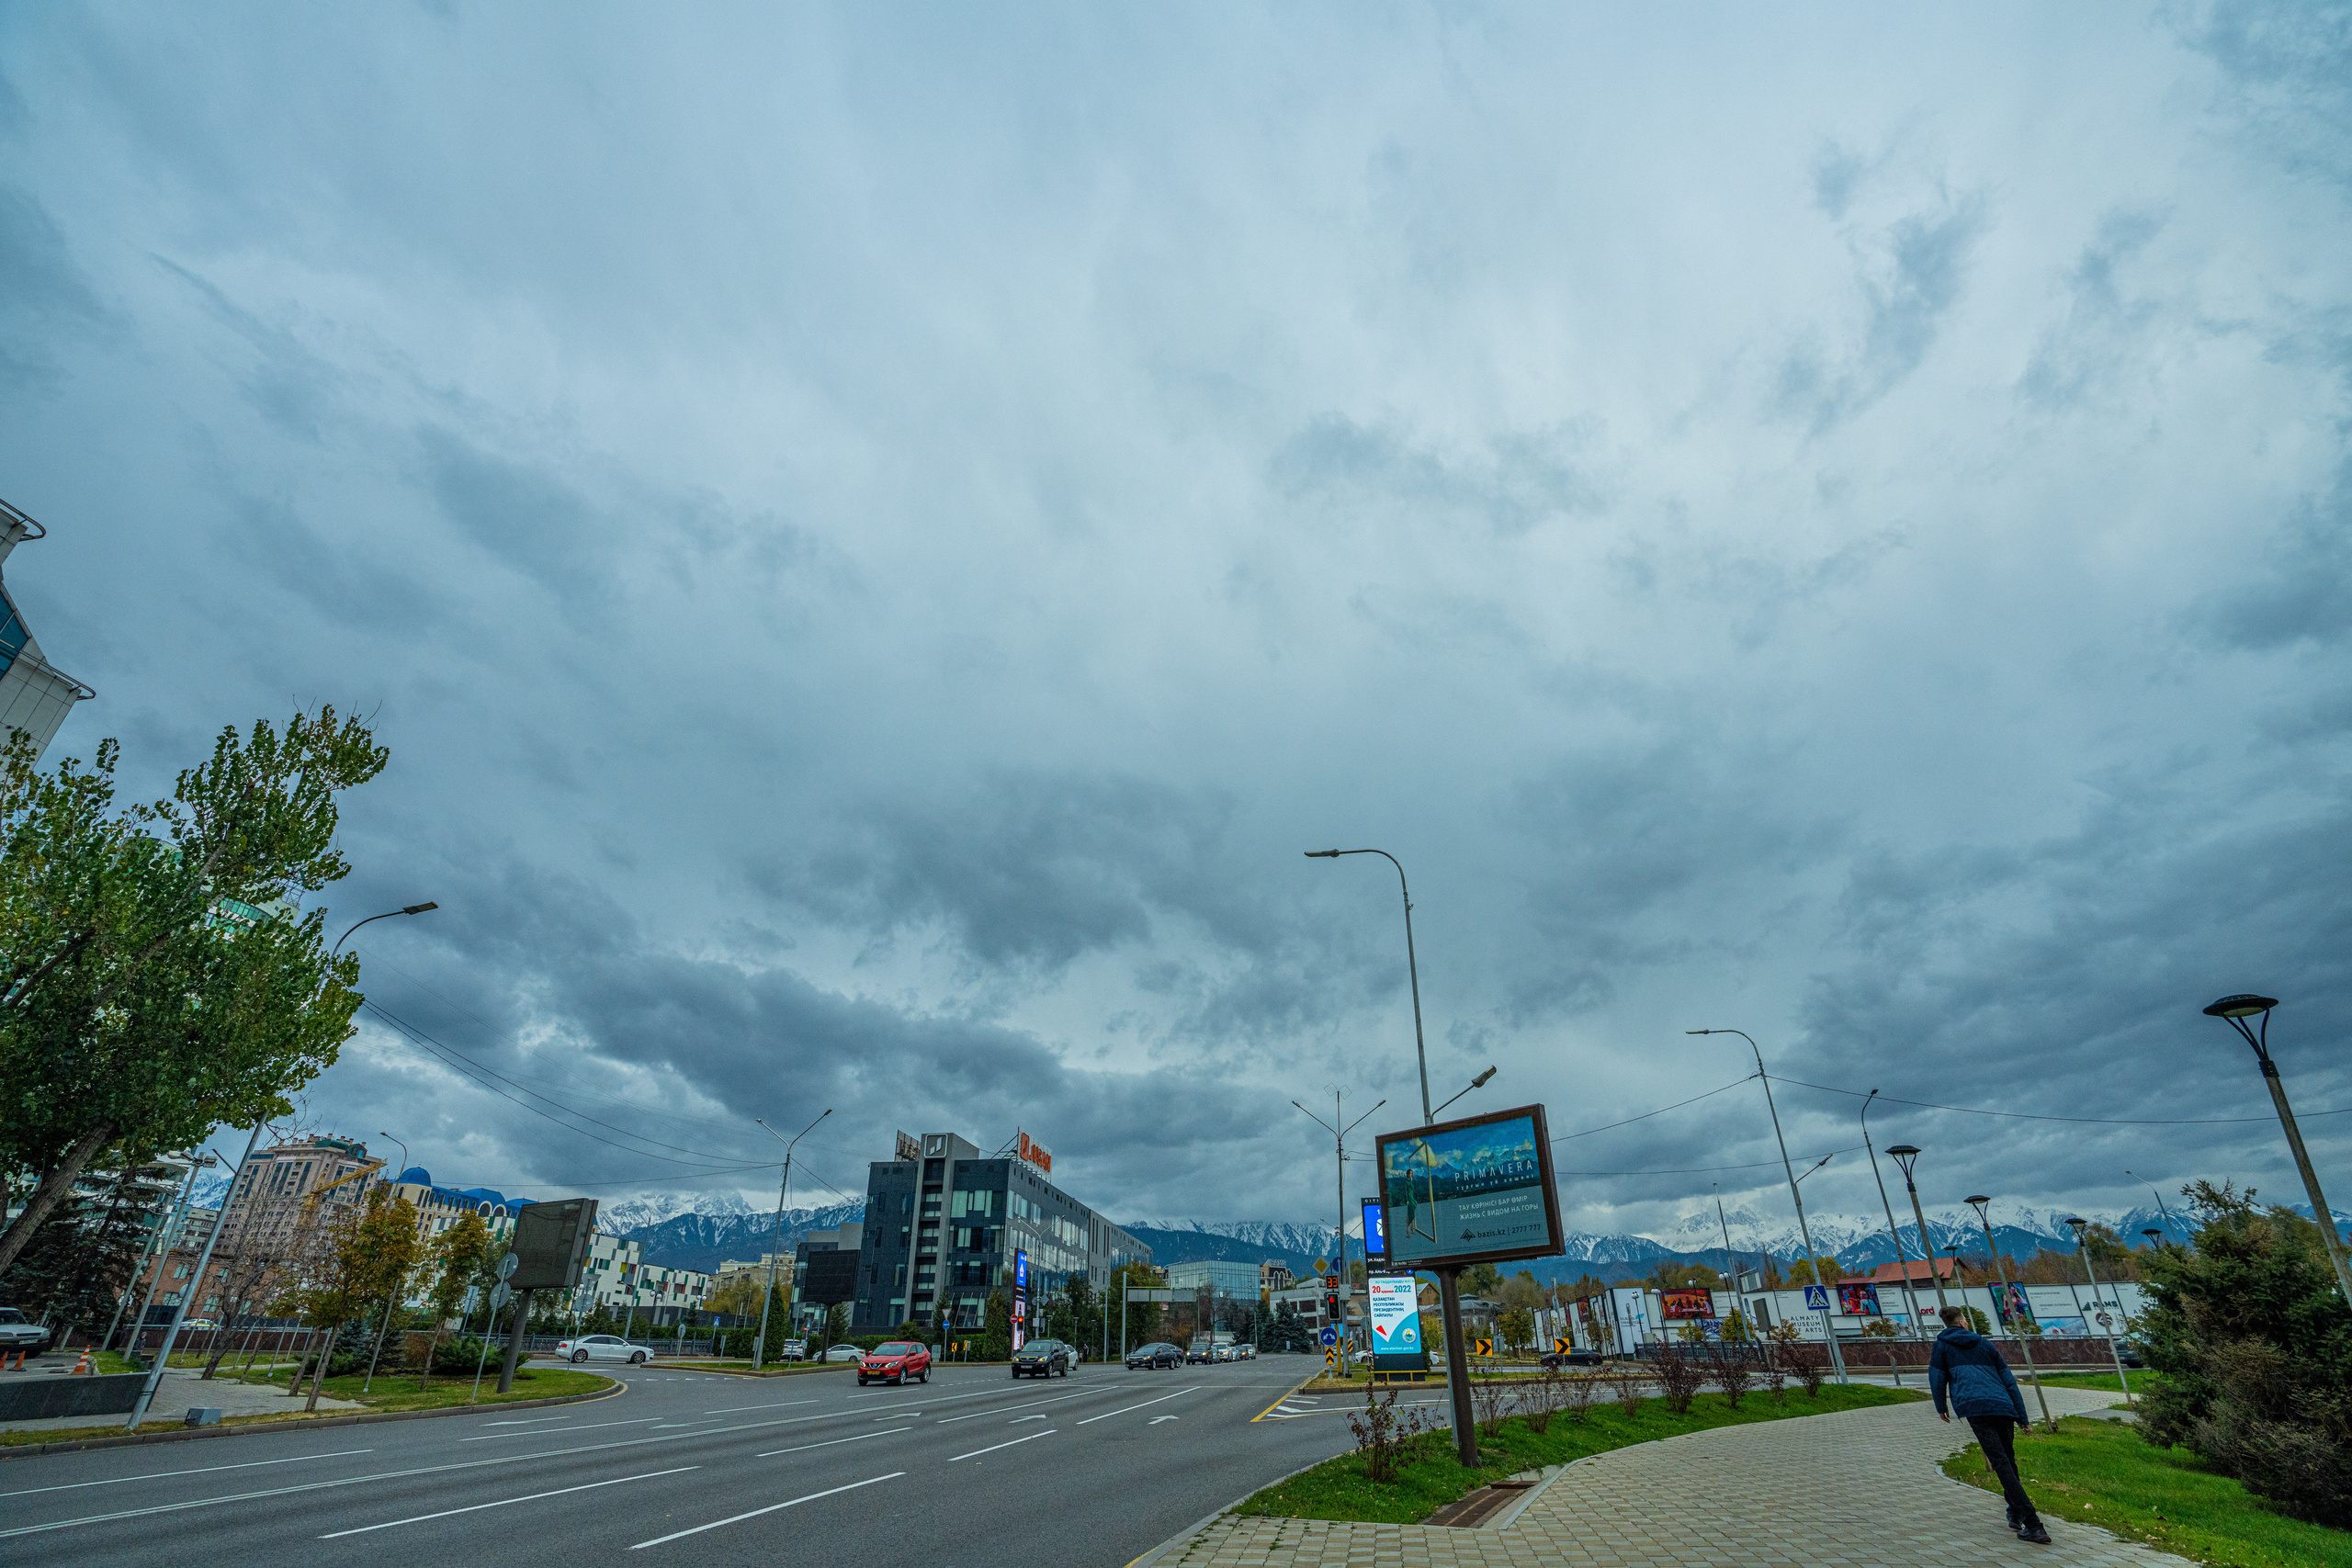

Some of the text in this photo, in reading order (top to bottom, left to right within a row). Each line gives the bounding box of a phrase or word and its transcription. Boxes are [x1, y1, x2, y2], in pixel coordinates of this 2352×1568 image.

[1029, 1144, 1051, 1173] JUSAN
[1454, 1160, 1533, 1182] PRIMAVERA
[1471, 1201, 1497, 1209] КӨРІНІСІ
[1459, 1213, 1481, 1221] ЖИЗНЬ
[1487, 1208, 1510, 1216] ВИДОМ
[1477, 1224, 1541, 1238] bazis.kz 2777 777
[1327, 1277, 1338, 1288] 33
[1372, 1285, 1381, 1293] 20
[1394, 1284, 1411, 1292] 2022
